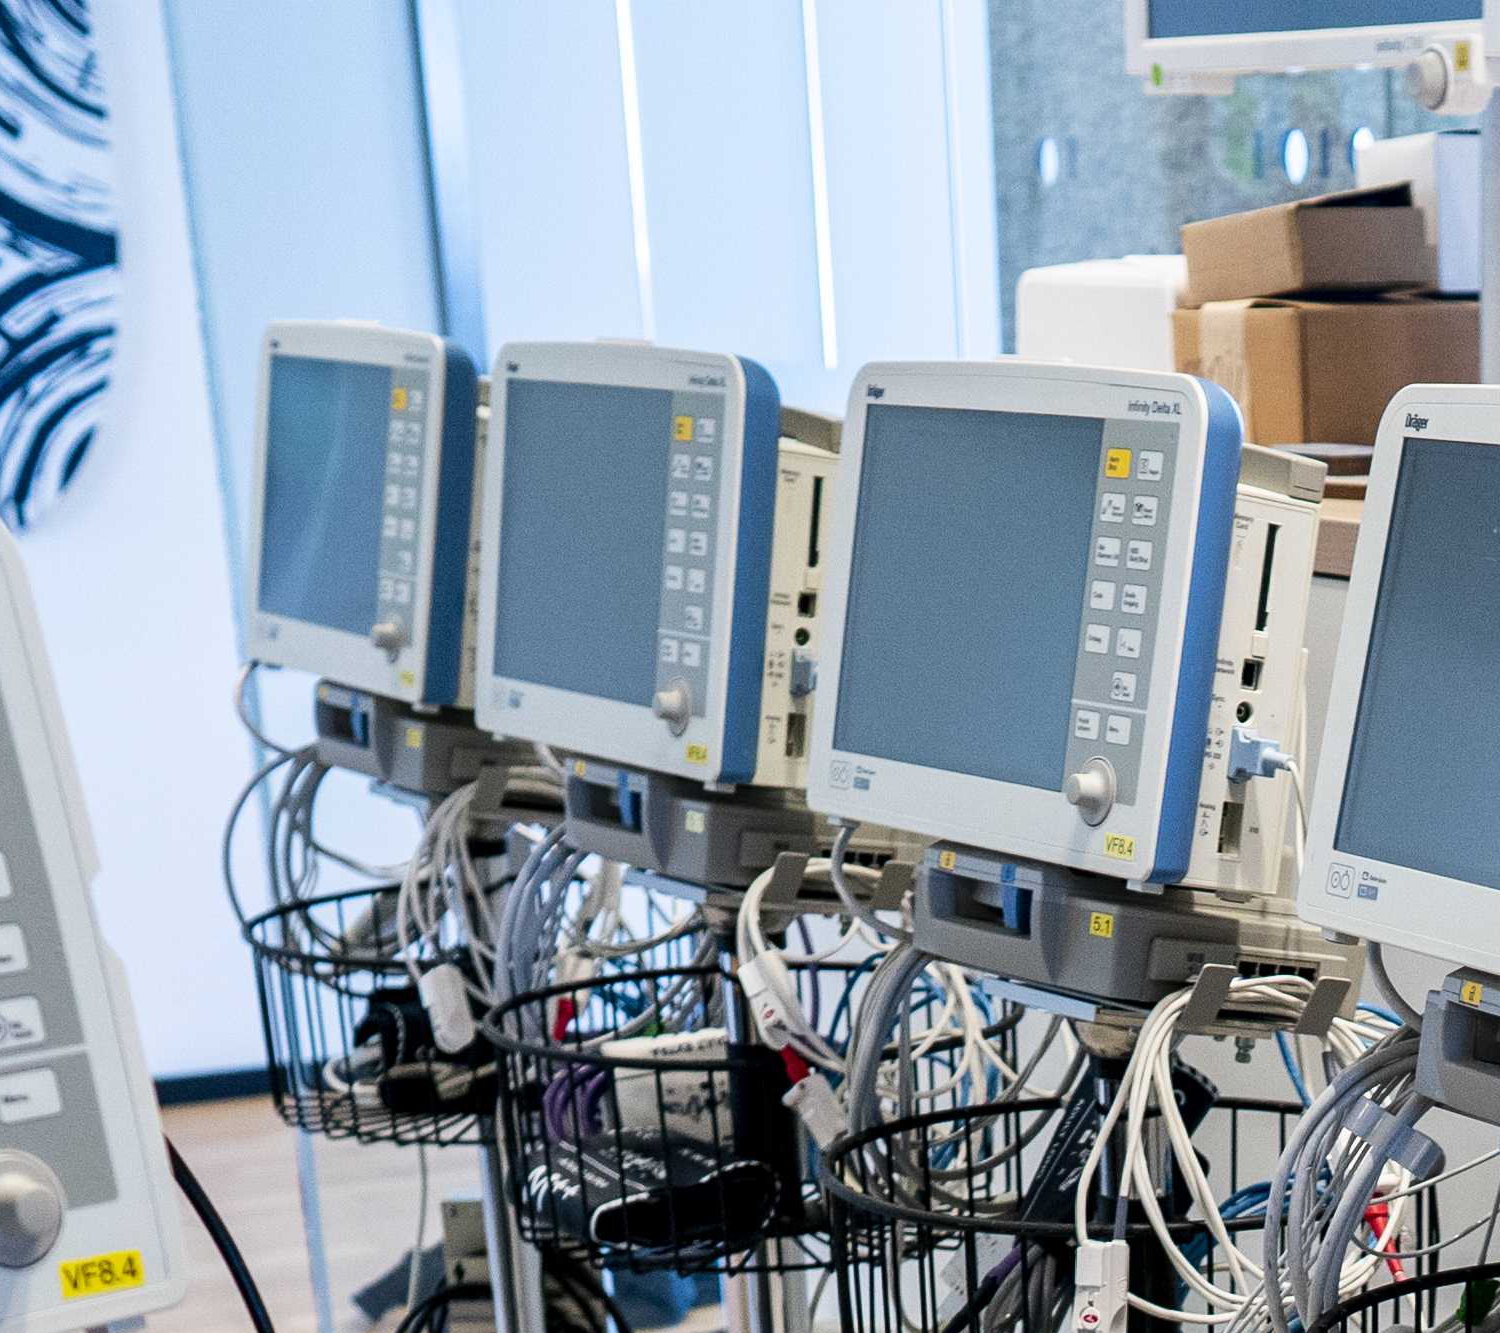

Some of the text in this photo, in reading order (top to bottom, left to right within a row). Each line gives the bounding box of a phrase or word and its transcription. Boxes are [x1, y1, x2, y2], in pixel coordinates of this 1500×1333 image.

[1405, 411, 1430, 433] Dräger
[1105, 836, 1134, 856] VF8.4
[1092, 914, 1113, 935] 5.1
[61, 1256, 141, 1293] VF8.4
